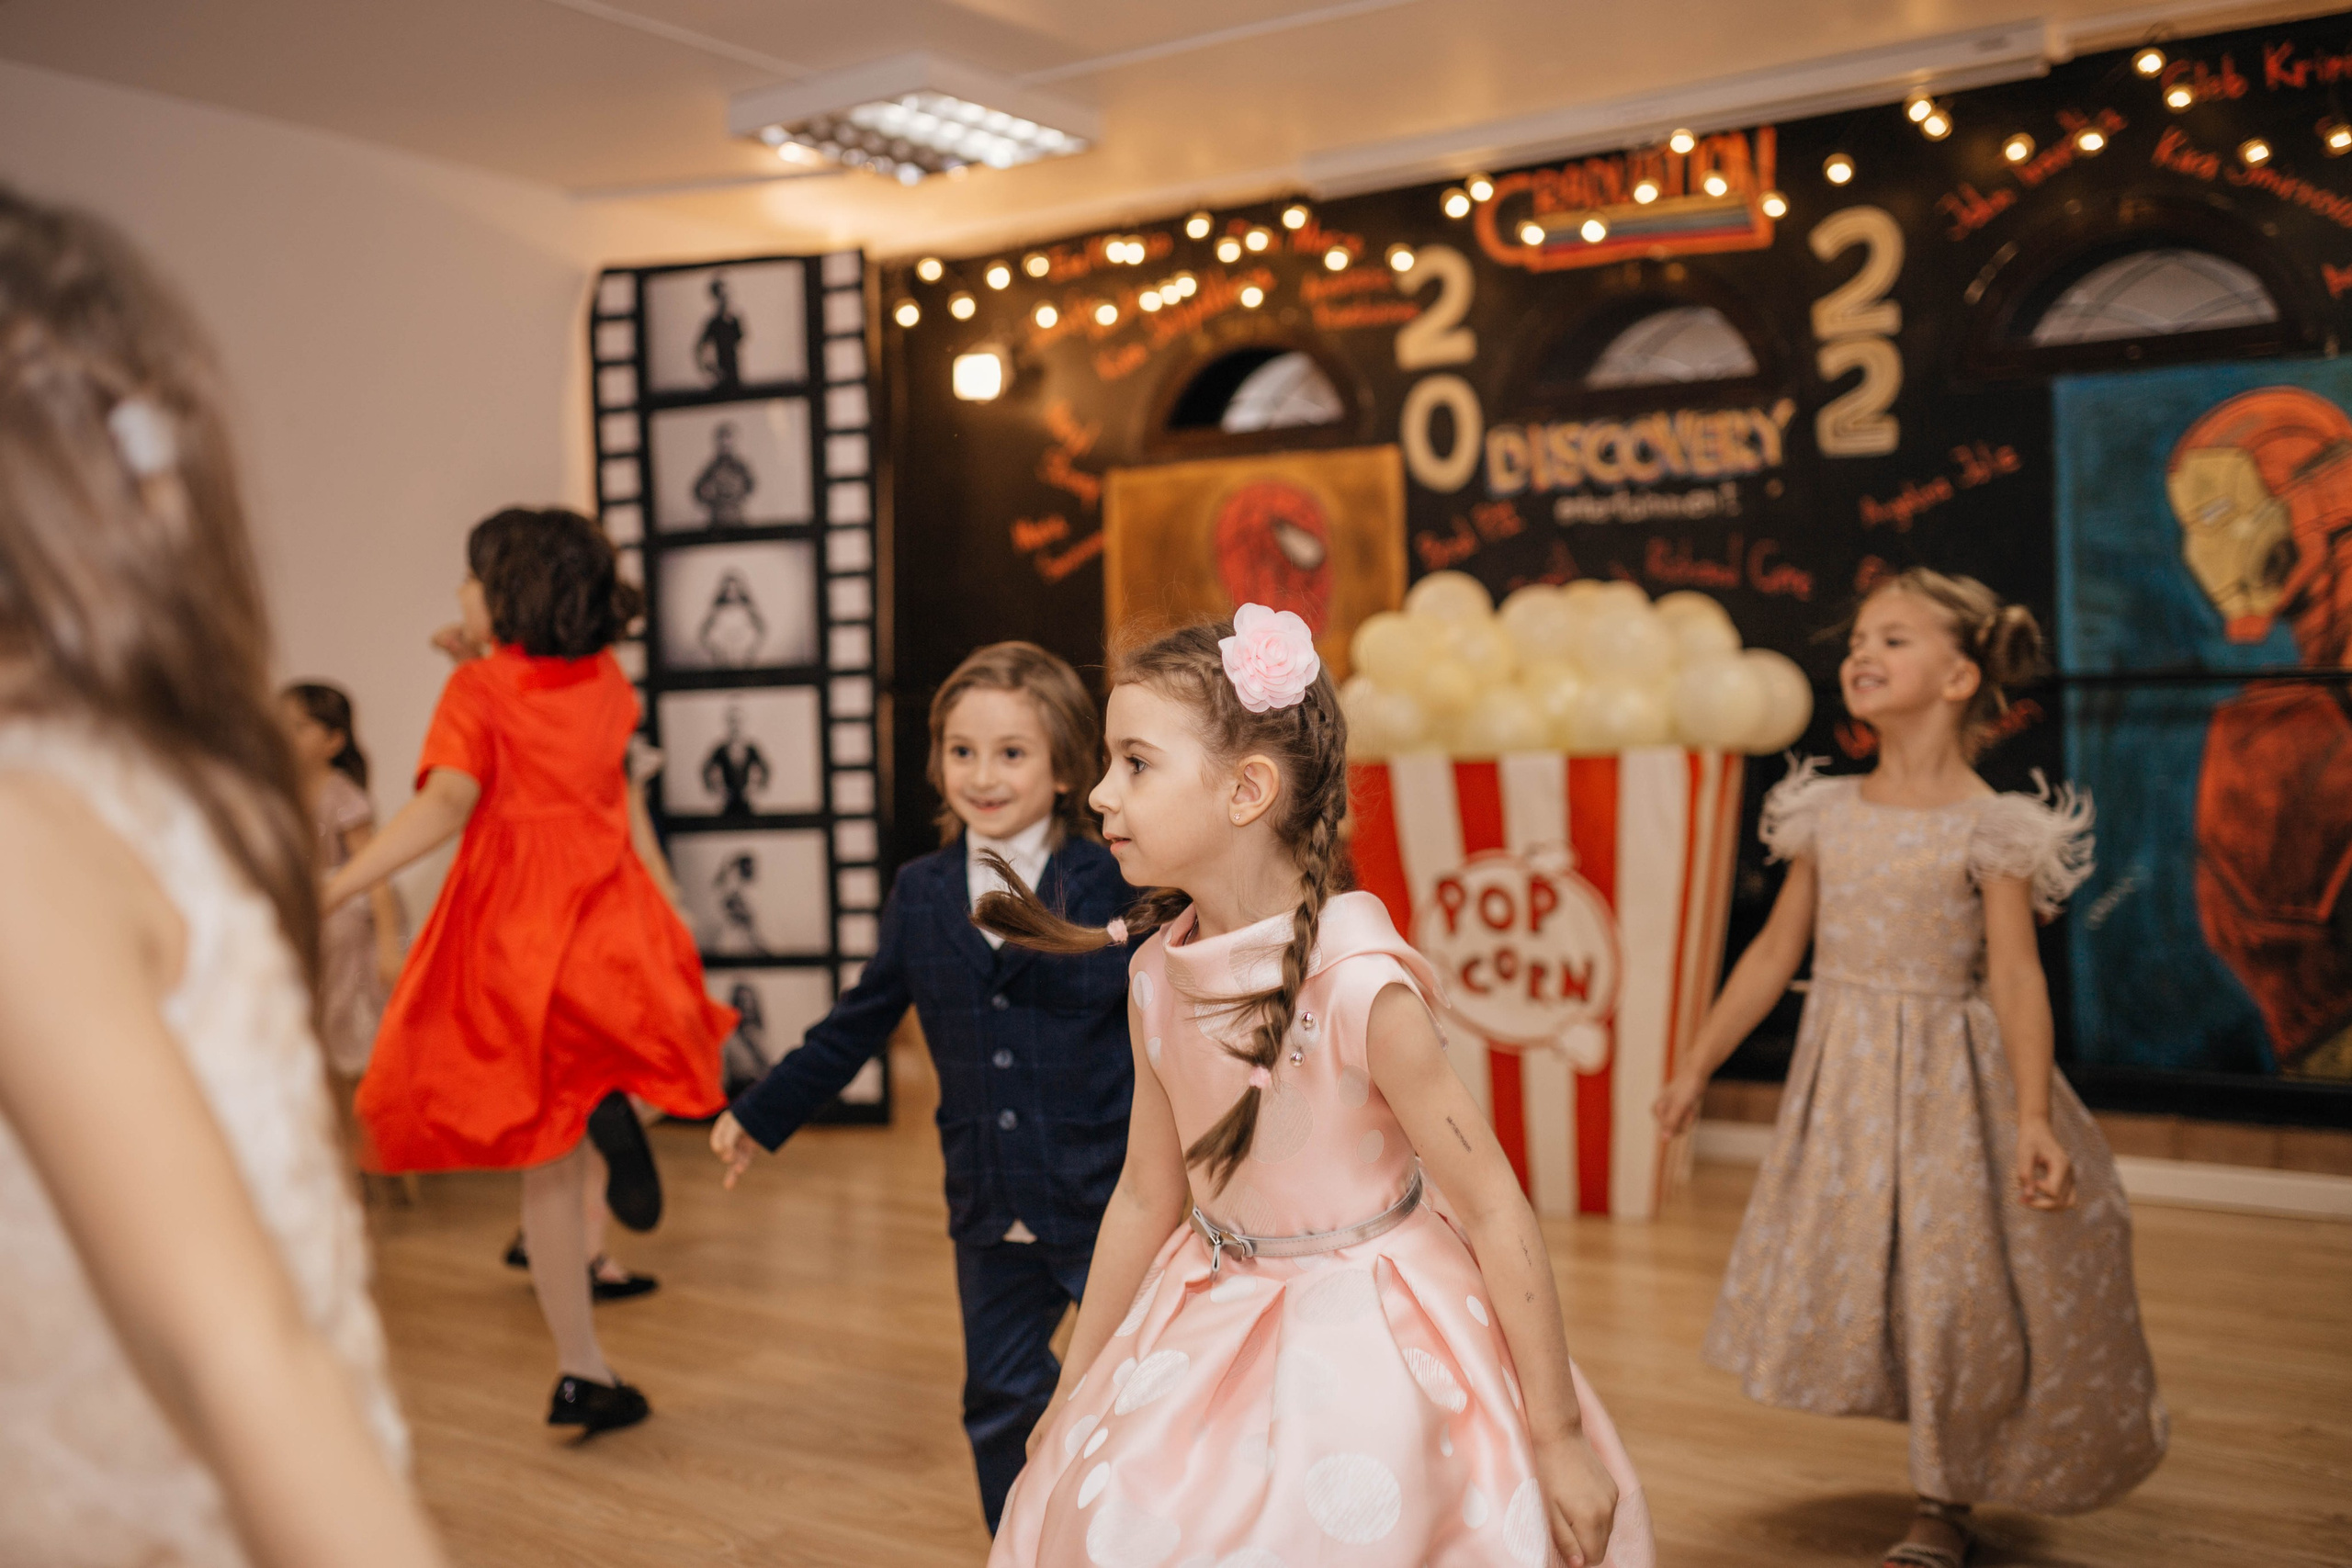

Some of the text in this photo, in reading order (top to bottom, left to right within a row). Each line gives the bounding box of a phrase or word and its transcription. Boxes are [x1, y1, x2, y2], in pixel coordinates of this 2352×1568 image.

[1487, 400, 1794, 494] DISCOVERY
[1435, 874, 1558, 937] POP
[1461, 947, 1595, 1003] CORN
